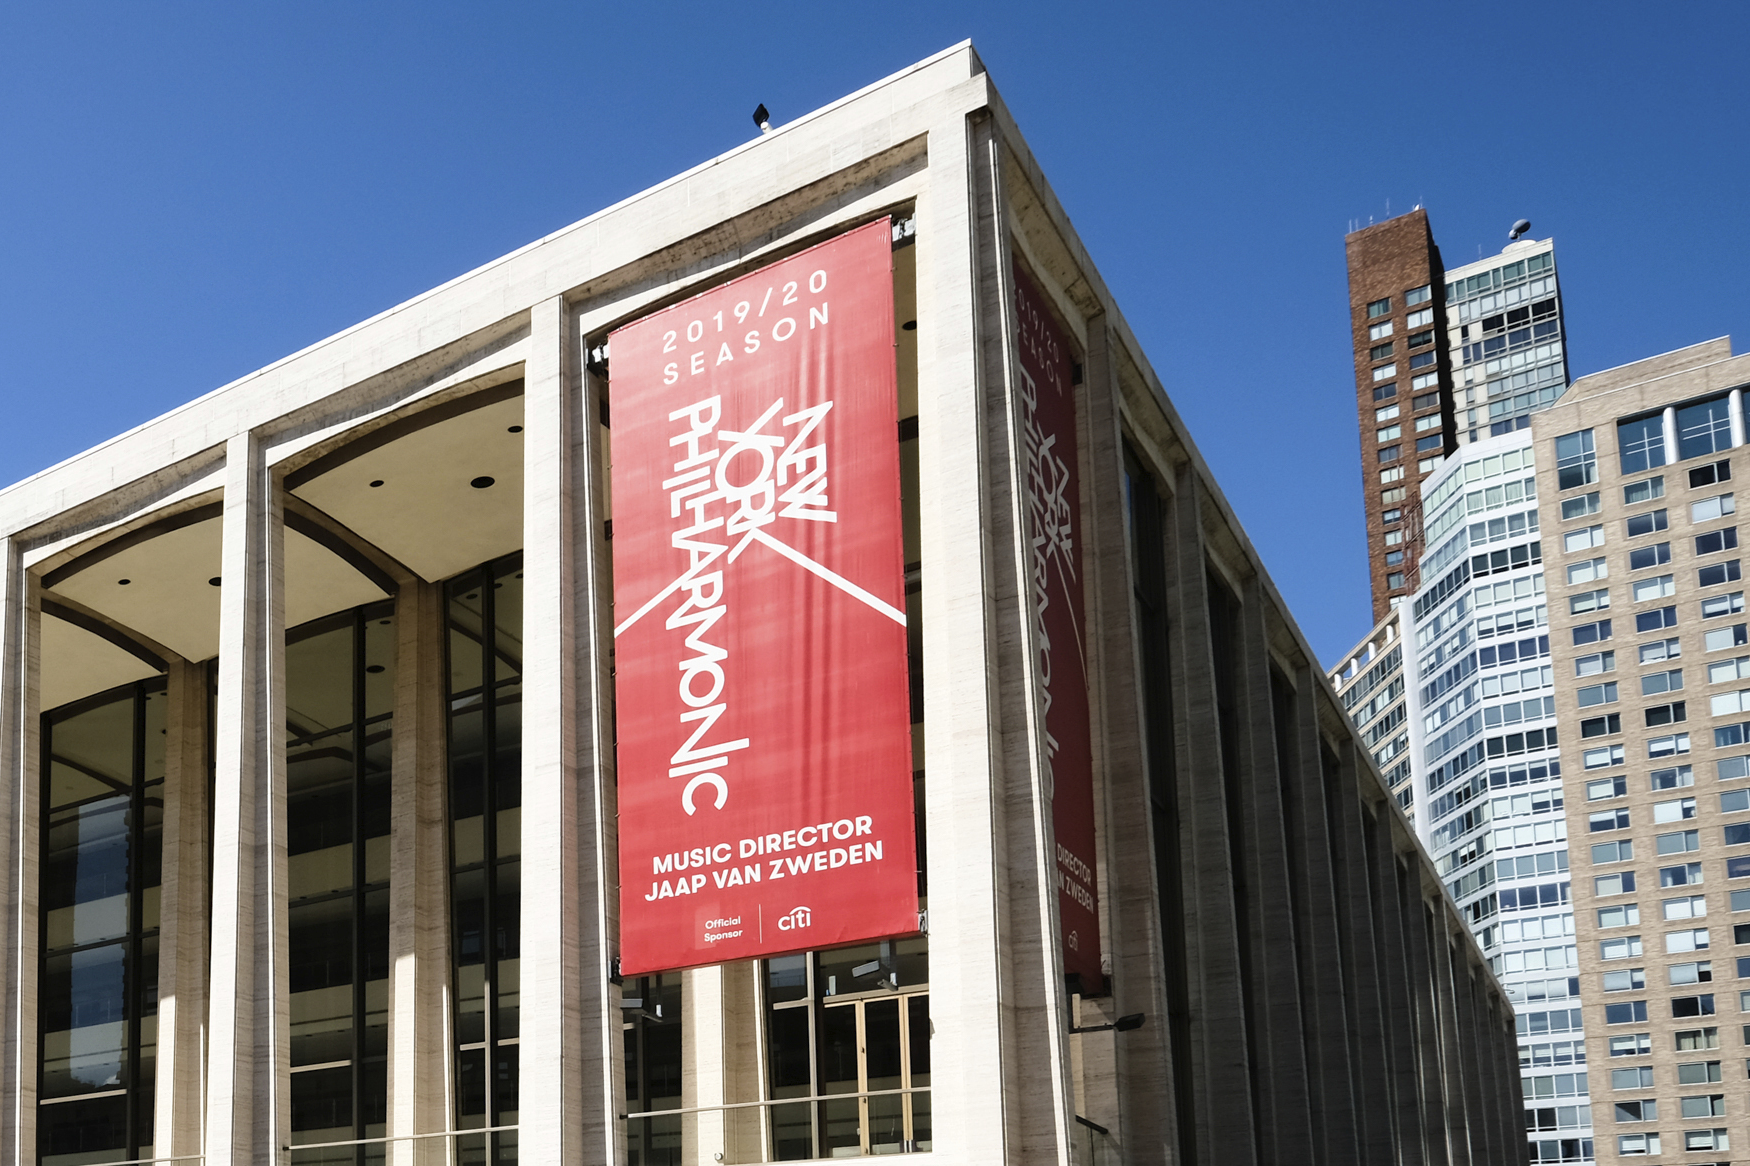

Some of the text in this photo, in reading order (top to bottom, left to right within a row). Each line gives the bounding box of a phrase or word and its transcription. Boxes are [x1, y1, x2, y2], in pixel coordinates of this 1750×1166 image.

[662, 269, 828, 354] 2019/20
[1018, 288, 1060, 364] 019/20
[662, 302, 830, 386] SEASON
[1015, 313, 1063, 397] EASON
[776, 400, 838, 524] NEW
[662, 394, 750, 817] PHILHARMONIC
[644, 840, 884, 902] JAAP VAN ZWEDEN
[652, 814, 874, 876] MUSIC DIRECTOR
[1057, 842, 1092, 887] DIRECTOR
[704, 915, 742, 930] Official
[777, 906, 812, 931] citi
[1065, 875, 1094, 915] ZWEDEN
[703, 929, 744, 944] Sponsor
